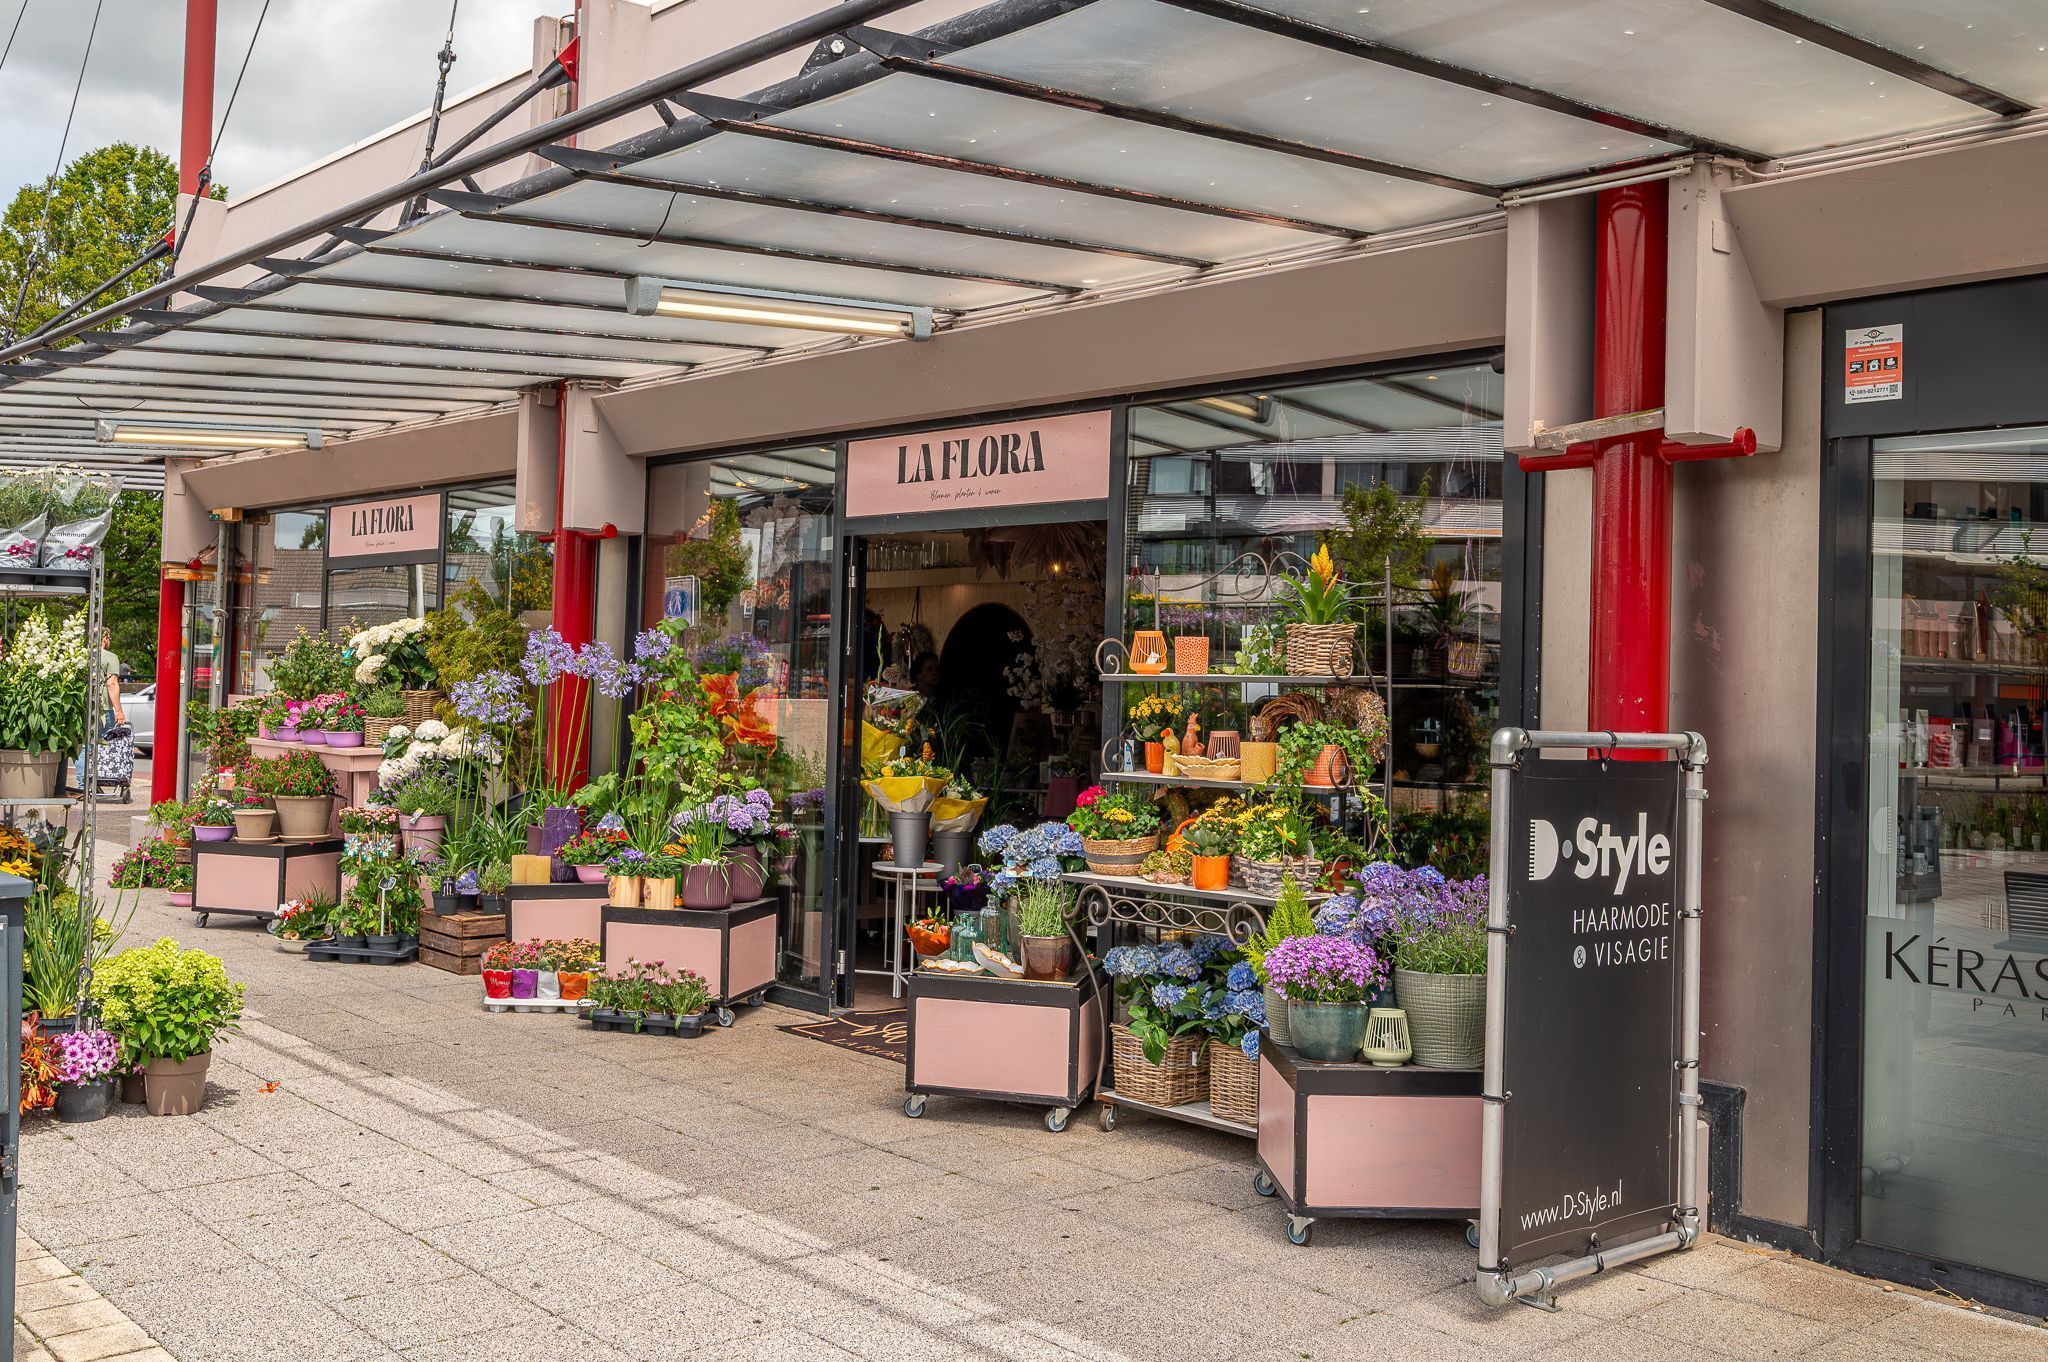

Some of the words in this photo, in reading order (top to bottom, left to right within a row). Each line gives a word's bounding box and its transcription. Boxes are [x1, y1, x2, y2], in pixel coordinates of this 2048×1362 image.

[896, 443, 935, 484] LA
[941, 430, 1046, 480] FLORA
[351, 509, 368, 537] LA
[370, 504, 414, 535] FLORA
[1573, 902, 1669, 934] HAARMODE
[1575, 947, 1585, 966] &
[1594, 936, 1669, 967] VISAGIE
[1520, 1179, 1622, 1231] www.D-Style.nl
